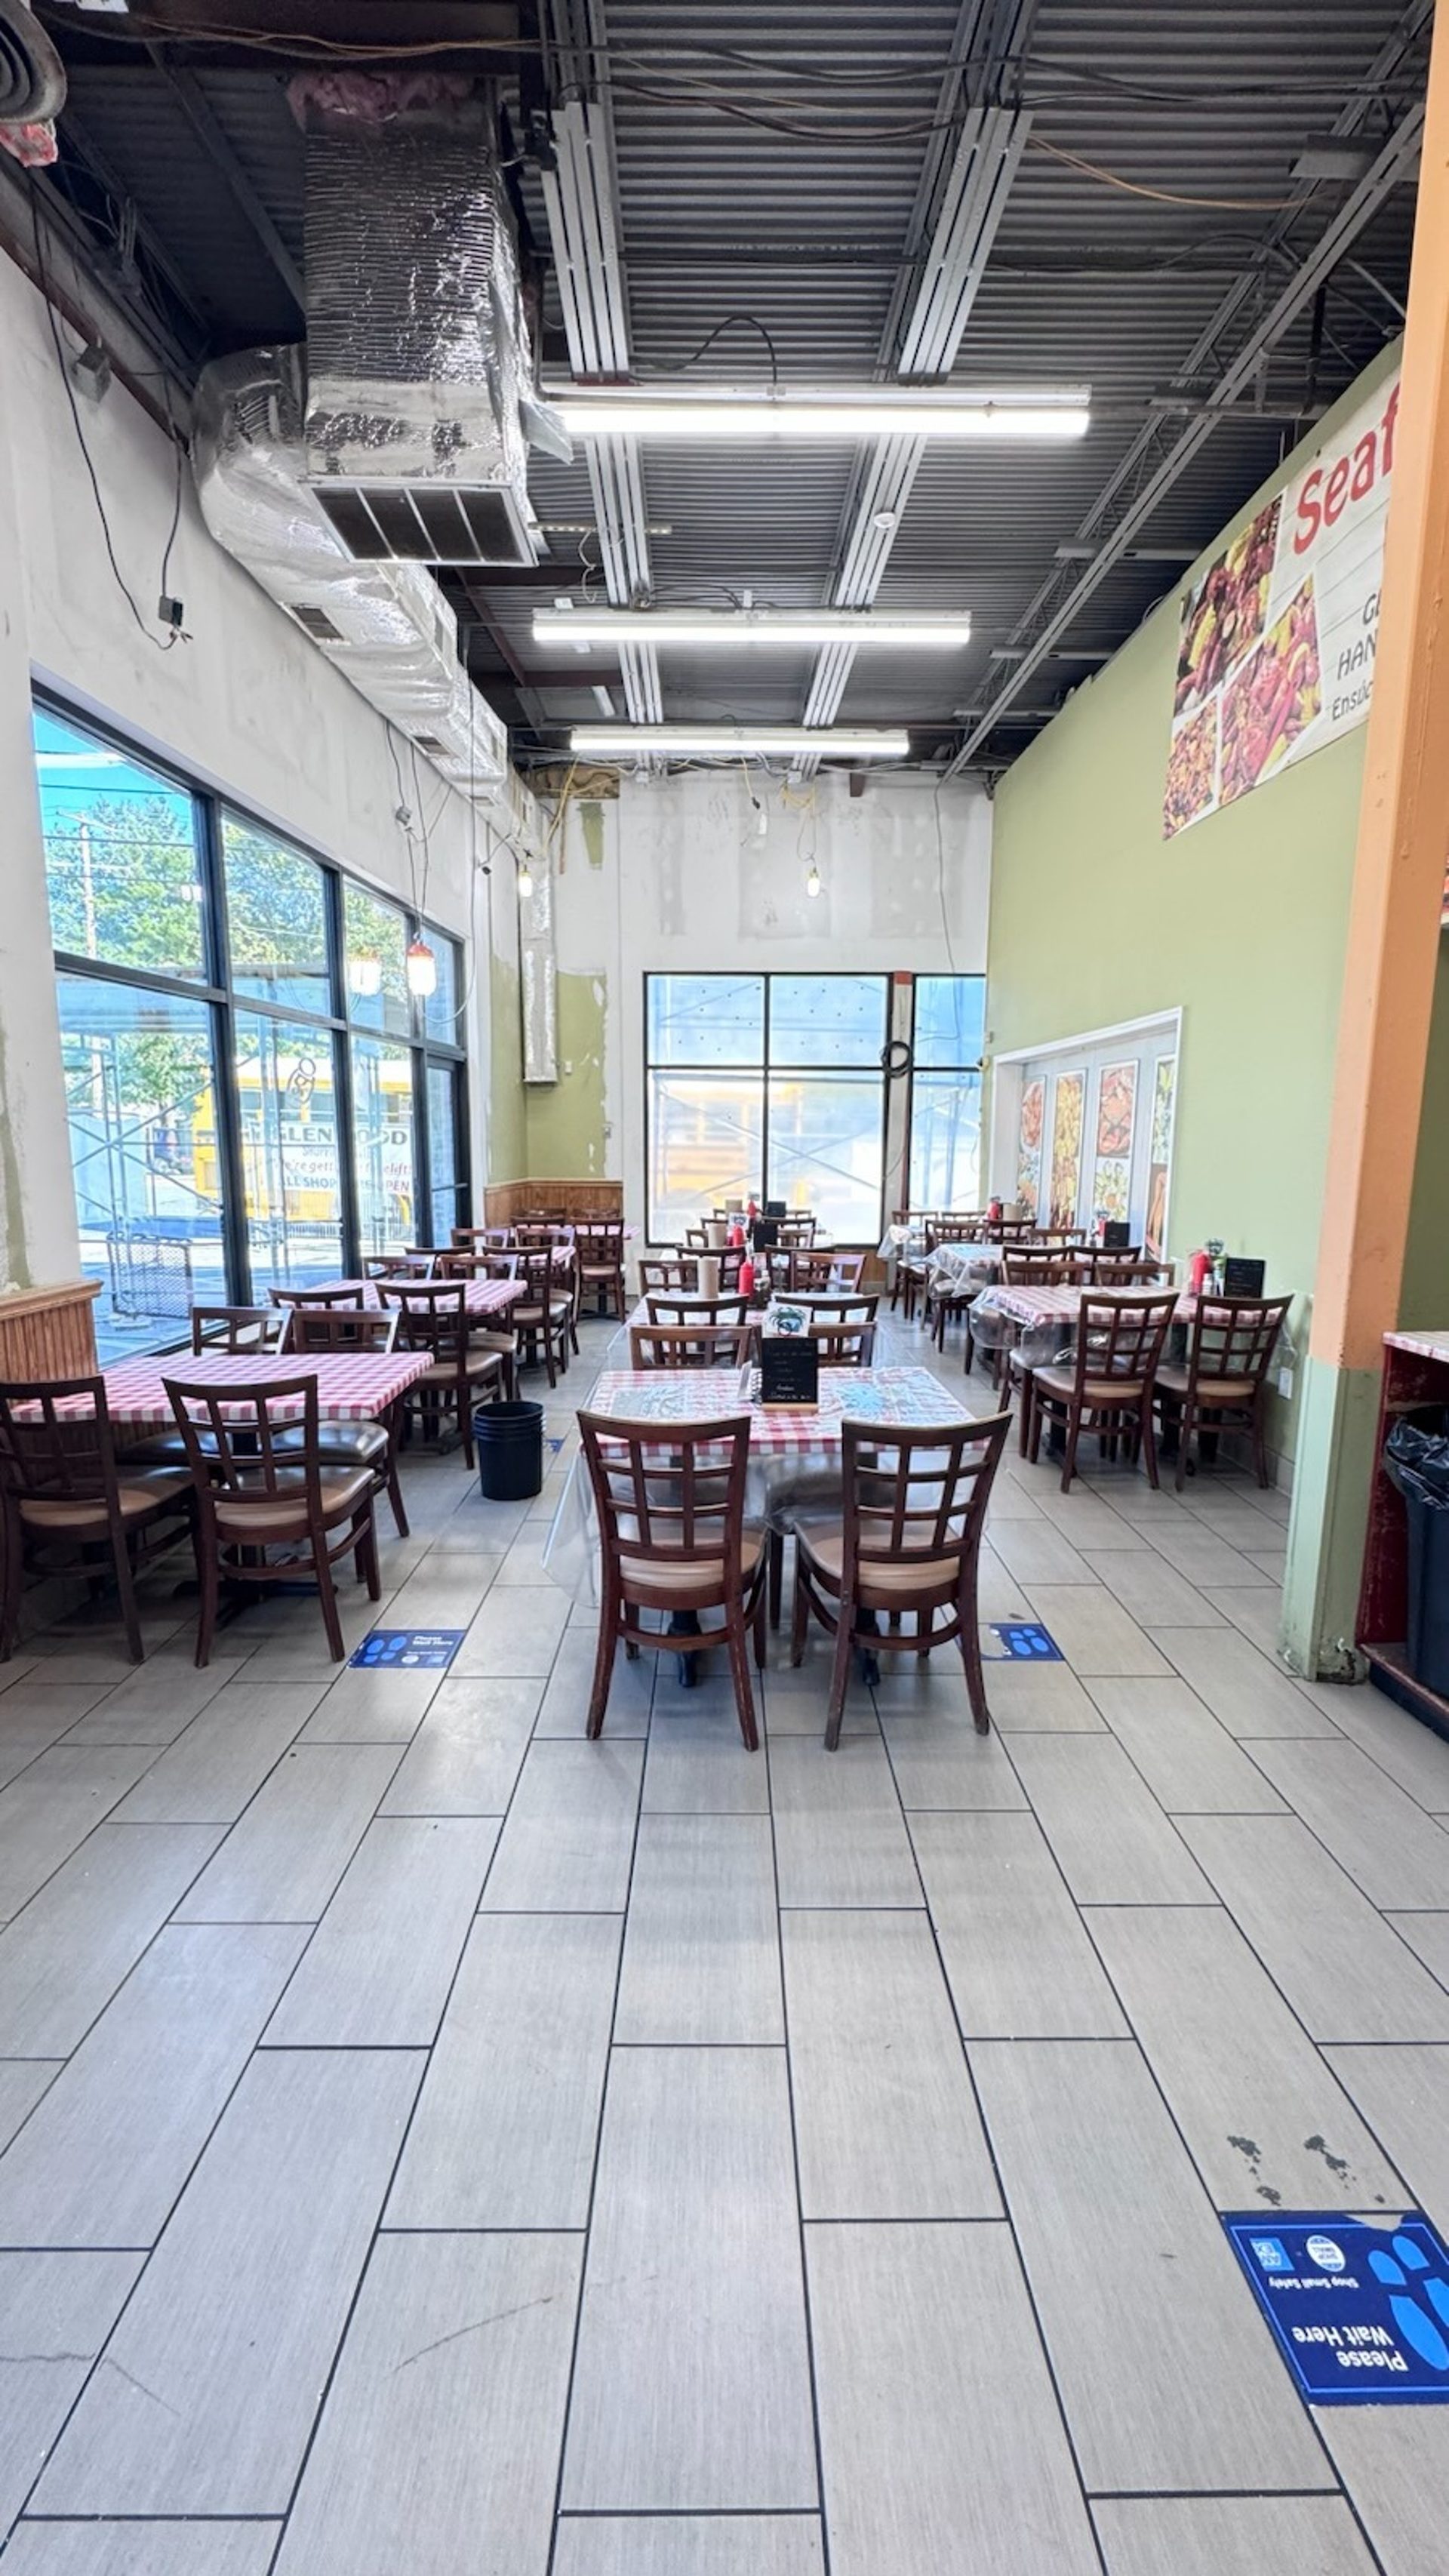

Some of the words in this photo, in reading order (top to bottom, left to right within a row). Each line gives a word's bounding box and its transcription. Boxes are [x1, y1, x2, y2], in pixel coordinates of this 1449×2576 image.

[1291, 2326, 1345, 2347] Here
[1342, 2325, 1395, 2347] Wait
[1335, 2350, 1410, 2371] Please
